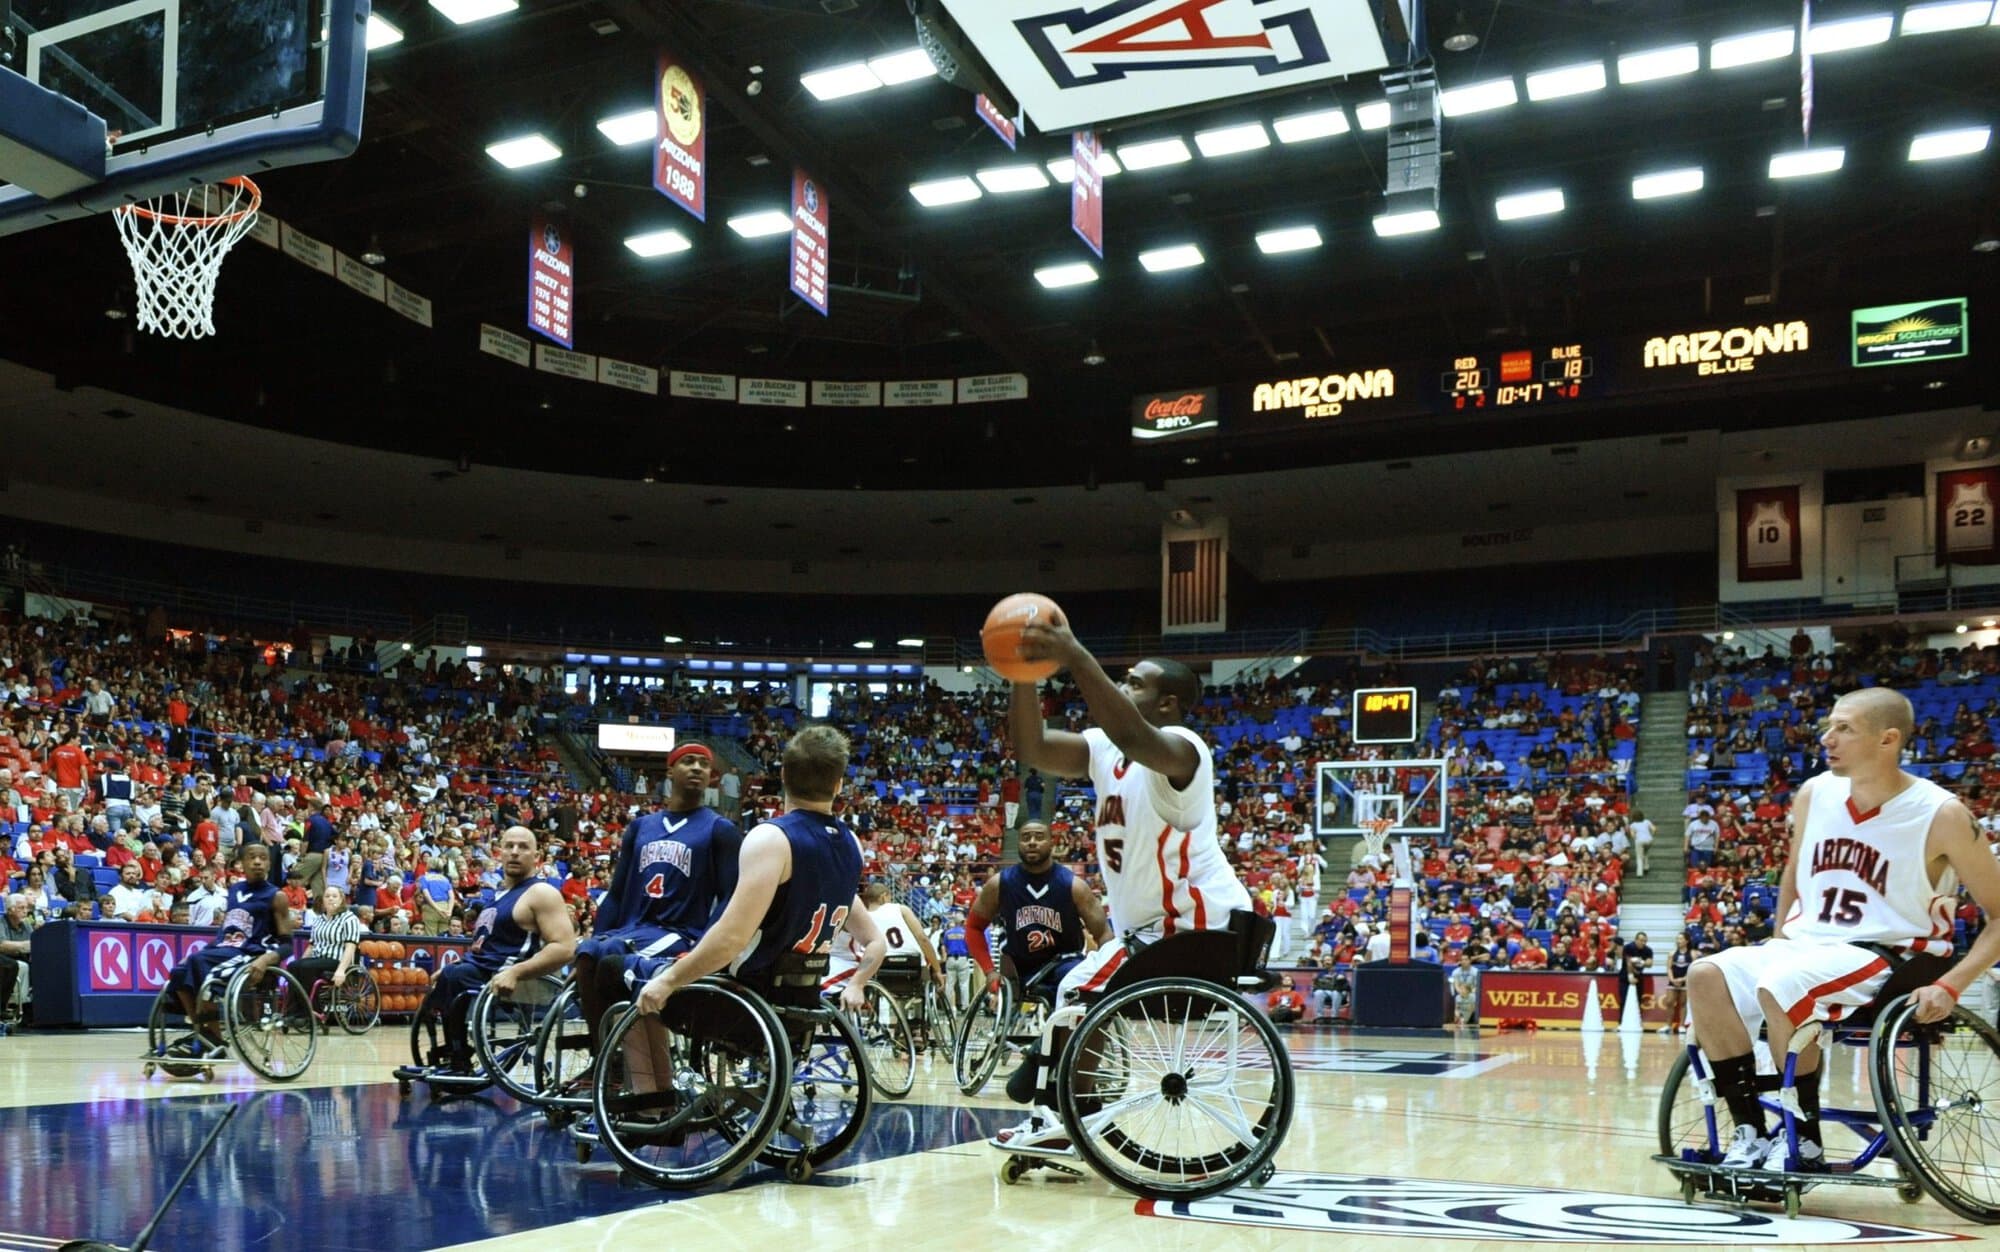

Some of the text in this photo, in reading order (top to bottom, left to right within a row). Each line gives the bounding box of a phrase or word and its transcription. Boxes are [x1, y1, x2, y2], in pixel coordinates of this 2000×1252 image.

[660, 138, 700, 176] ARIZONA
[665, 165, 695, 201] 1988
[534, 248, 570, 277] ARIZONA
[534, 270, 559, 289] SWEET
[1644, 320, 1808, 368] ARIZONA
[1857, 326, 1960, 345] BRIGHT SOLUTIONS
[1552, 345, 1581, 359] BLUE
[1455, 357, 1477, 370] RED
[1565, 359, 1583, 378] 18
[1698, 357, 1754, 376] BLUE
[1456, 370, 1480, 389] 20
[1253, 368, 1394, 412] ARIZONA
[1496, 383, 1543, 405] 10:47
[1305, 403, 1342, 418] RED
[1955, 508, 1985, 527] 22
[1758, 526, 1779, 544] 10
[1365, 693, 1410, 711] 10:47
[639, 839, 692, 878] ARIZONA
[1811, 837, 1889, 898] ARIZONA
[645, 873, 664, 898] 4
[1817, 886, 1868, 928] 15
[1016, 905, 1063, 933] ARIZONA
[1027, 930, 1055, 952] 21
[1487, 990, 1580, 1008] WELLS
